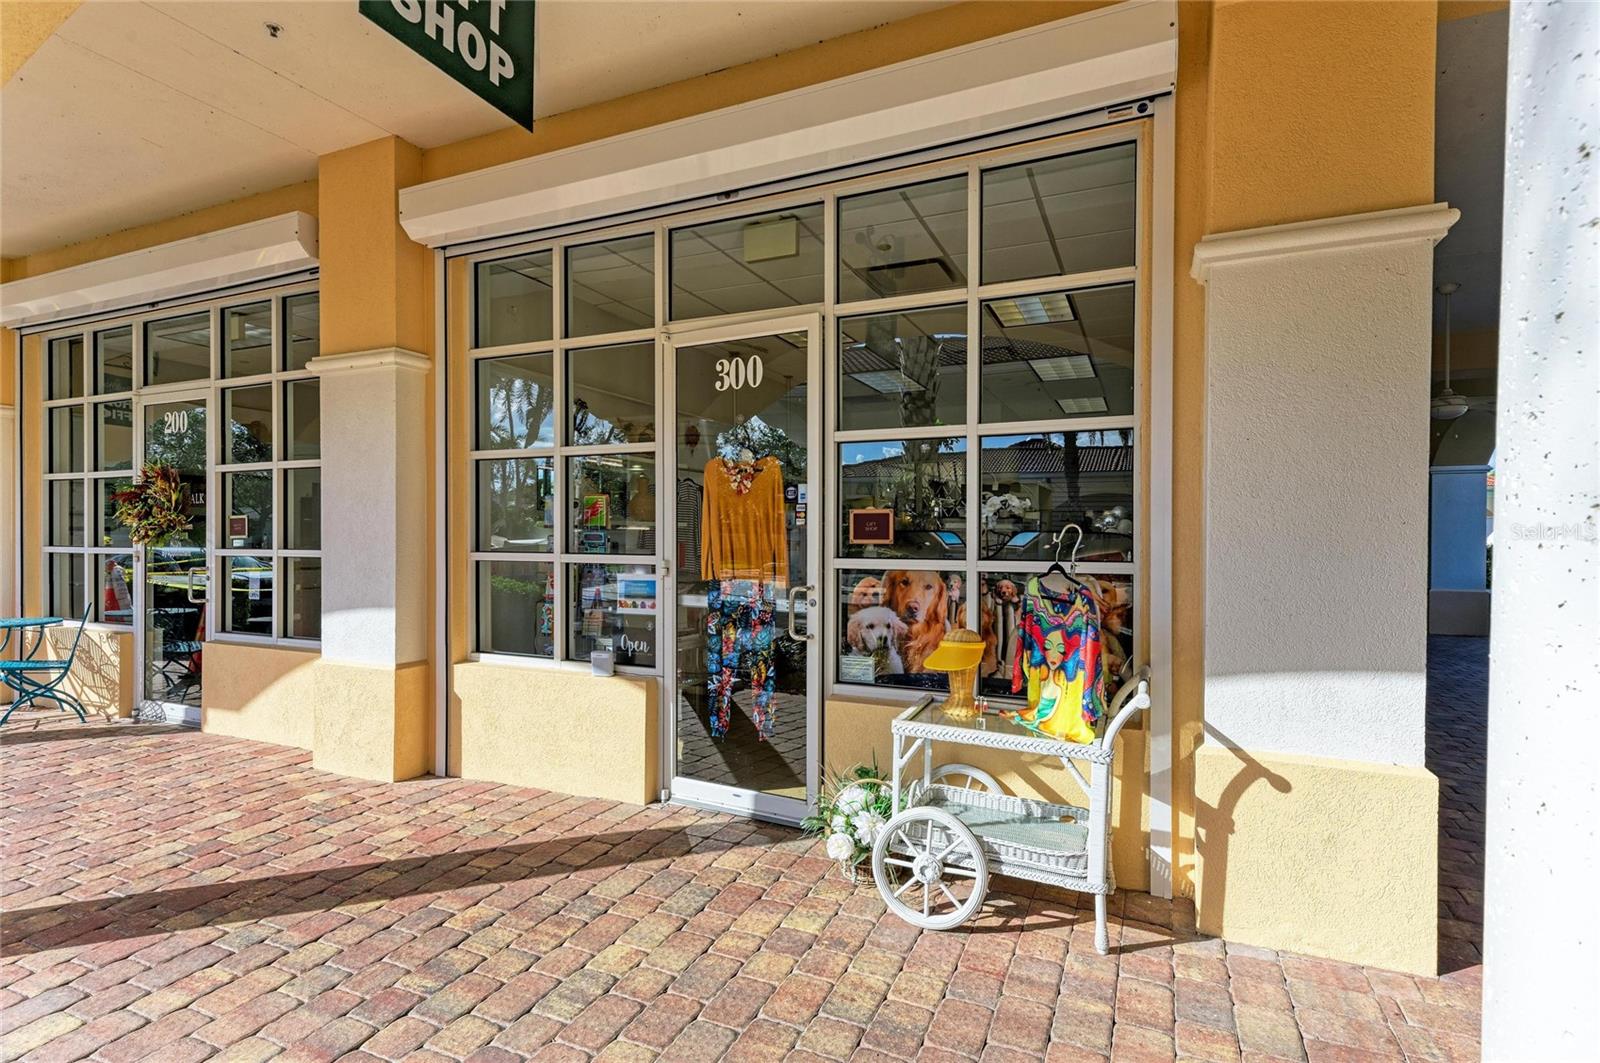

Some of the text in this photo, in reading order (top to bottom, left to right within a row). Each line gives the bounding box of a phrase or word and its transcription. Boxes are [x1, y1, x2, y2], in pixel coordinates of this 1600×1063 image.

[715, 355, 763, 391] 300
[164, 411, 188, 433] 200
[621, 634, 650, 657] Open
